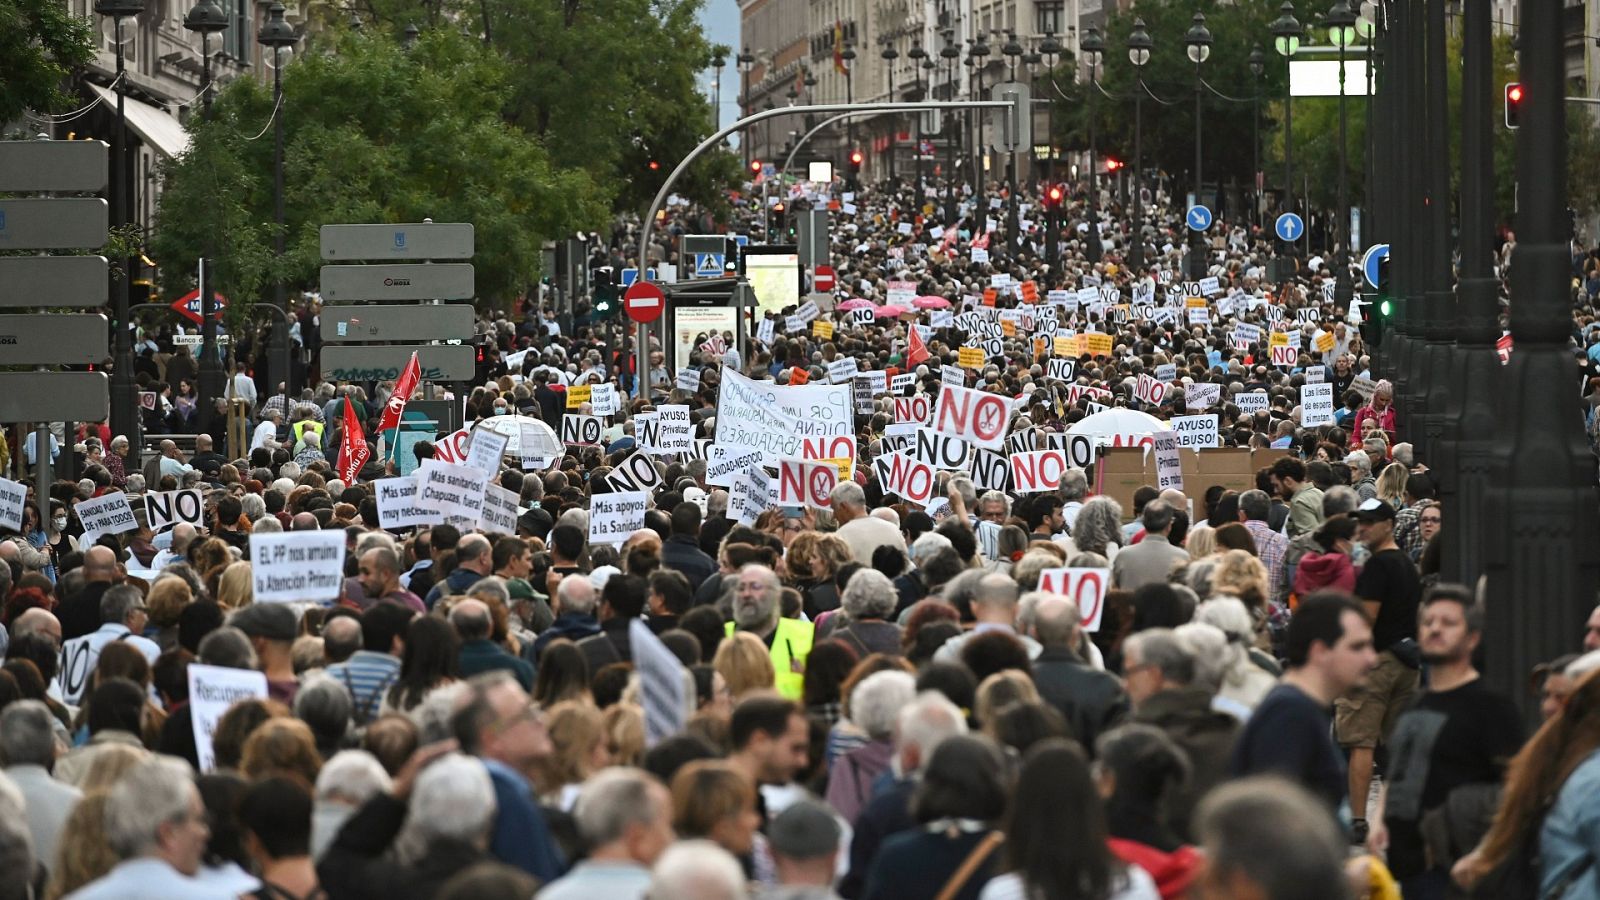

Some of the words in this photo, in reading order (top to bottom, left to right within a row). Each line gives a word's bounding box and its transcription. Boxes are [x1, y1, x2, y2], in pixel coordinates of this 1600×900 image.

[1182, 283, 1200, 296] NO
[853, 309, 873, 322] NO
[1114, 308, 1126, 322] NO
[1267, 305, 1282, 322] NO
[1298, 309, 1318, 323] NO
[984, 323, 1003, 338] NO
[1020, 315, 1033, 330] NO
[1040, 318, 1057, 333] NO
[176, 336, 196, 344] Banco
[981, 340, 1001, 356] NO
[1273, 347, 1297, 364] NO
[1048, 360, 1072, 380] NO
[1304, 388, 1314, 397] Las
[1316, 387, 1330, 396] listas
[895, 398, 927, 422] NO
[1304, 402, 1312, 410] de
[1312, 401, 1331, 410] espera
[659, 411, 688, 421] AYUSO:
[937, 388, 1006, 441] NO
[564, 416, 601, 444] NO
[662, 439, 671, 449] es
[917, 429, 968, 468] NO
[1011, 428, 1037, 454] NO
[608, 454, 657, 492] NO
[707, 450, 764, 480] SANIDAD-NEGOCIO
[970, 448, 1007, 491] NO
[1013, 451, 1065, 490] NO
[781, 461, 836, 507] NO
[889, 453, 932, 500] NO
[1161, 476, 1169, 486] es
[147, 490, 201, 527] NO
[382, 509, 400, 522] muy
[592, 501, 613, 522] ¡Más
[615, 500, 645, 520] apoyos
[86, 522, 95, 531] DE
[98, 517, 113, 528] PARA
[592, 530, 597, 540] a
[599, 527, 608, 539] la
[259, 545, 271, 565] EL
[273, 544, 287, 563] PP
[289, 546, 306, 562] nos
[307, 542, 338, 561] arruina
[256, 575, 264, 593] la
[266, 569, 306, 592] Atención
[58, 640, 89, 696] NO
